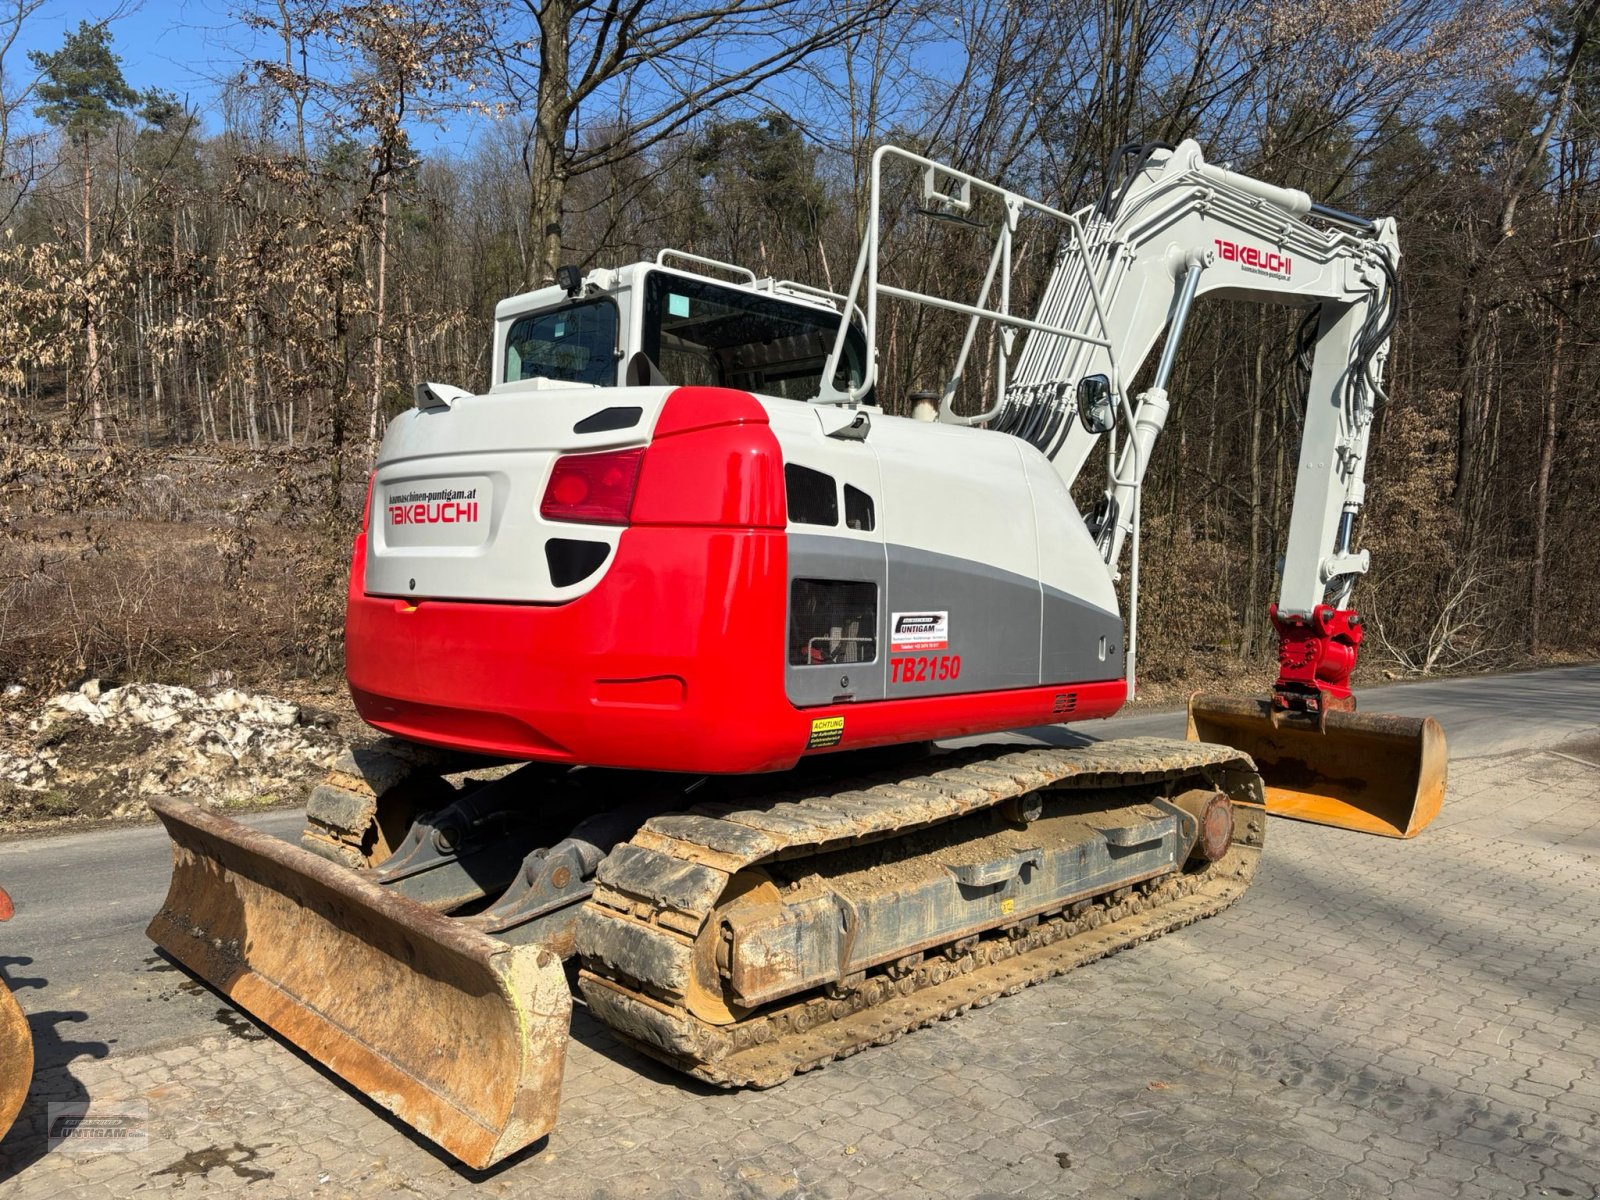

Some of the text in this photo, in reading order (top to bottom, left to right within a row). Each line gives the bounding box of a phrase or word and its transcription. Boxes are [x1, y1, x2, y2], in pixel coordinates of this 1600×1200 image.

[1215, 239, 1292, 275] TAKEUCHI
[389, 502, 478, 525] TAKEUCHI
[890, 655, 961, 684] TB2150
[814, 719, 843, 730] ACHTUNG
